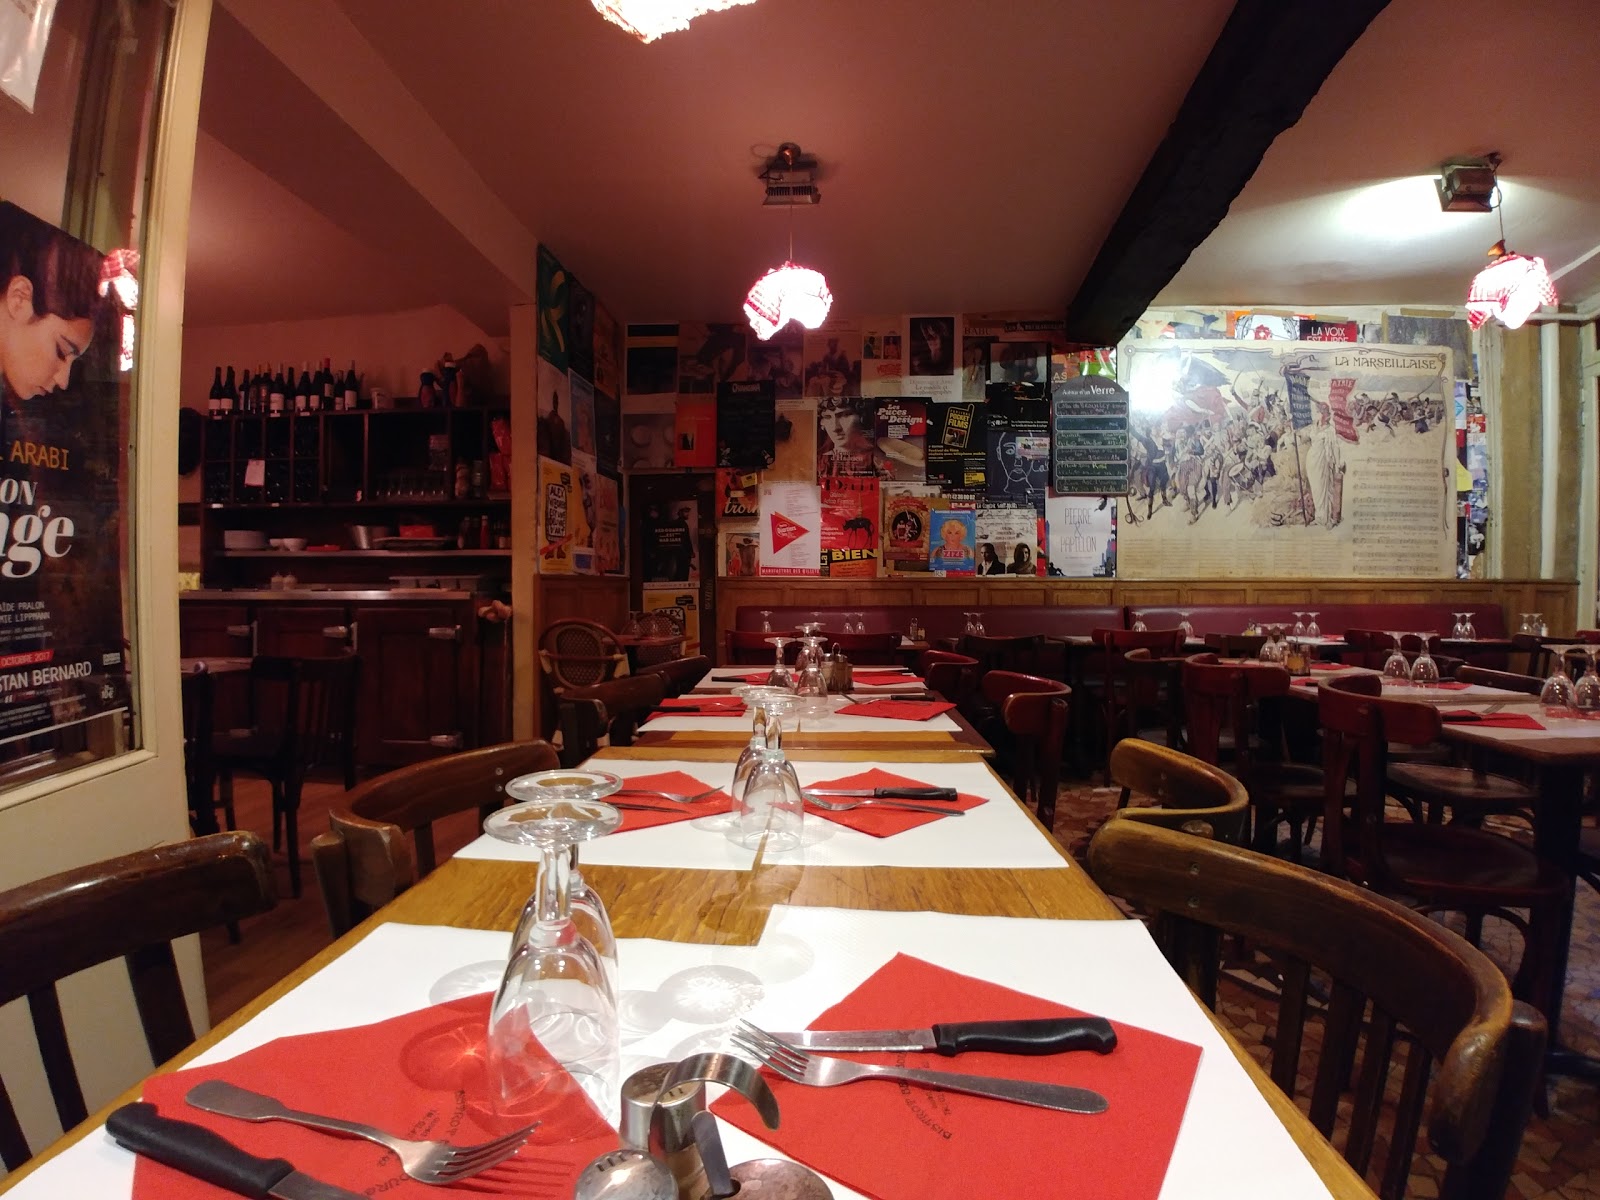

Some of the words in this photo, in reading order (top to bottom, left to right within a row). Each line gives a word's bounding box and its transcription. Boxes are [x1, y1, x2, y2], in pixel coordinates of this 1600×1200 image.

[1312, 326, 1323, 336] LA
[1325, 325, 1346, 336] VOIX
[1335, 356, 1350, 367] LA
[1353, 356, 1437, 370] MARSEILLAISE
[1091, 385, 1116, 395] Verre
[877, 408, 907, 416] Puces
[949, 413, 971, 422] POCKET
[888, 415, 924, 425] Design
[948, 419, 969, 429] FILMS
[10, 440, 70, 471] ARABI
[1064, 507, 1093, 525] PIERRE
[1060, 536, 1097, 553] PAPILLON
[831, 549, 878, 561] BIEN
[2, 655, 33, 667] OCTOBRE
[32, 661, 92, 687] BERNARD
